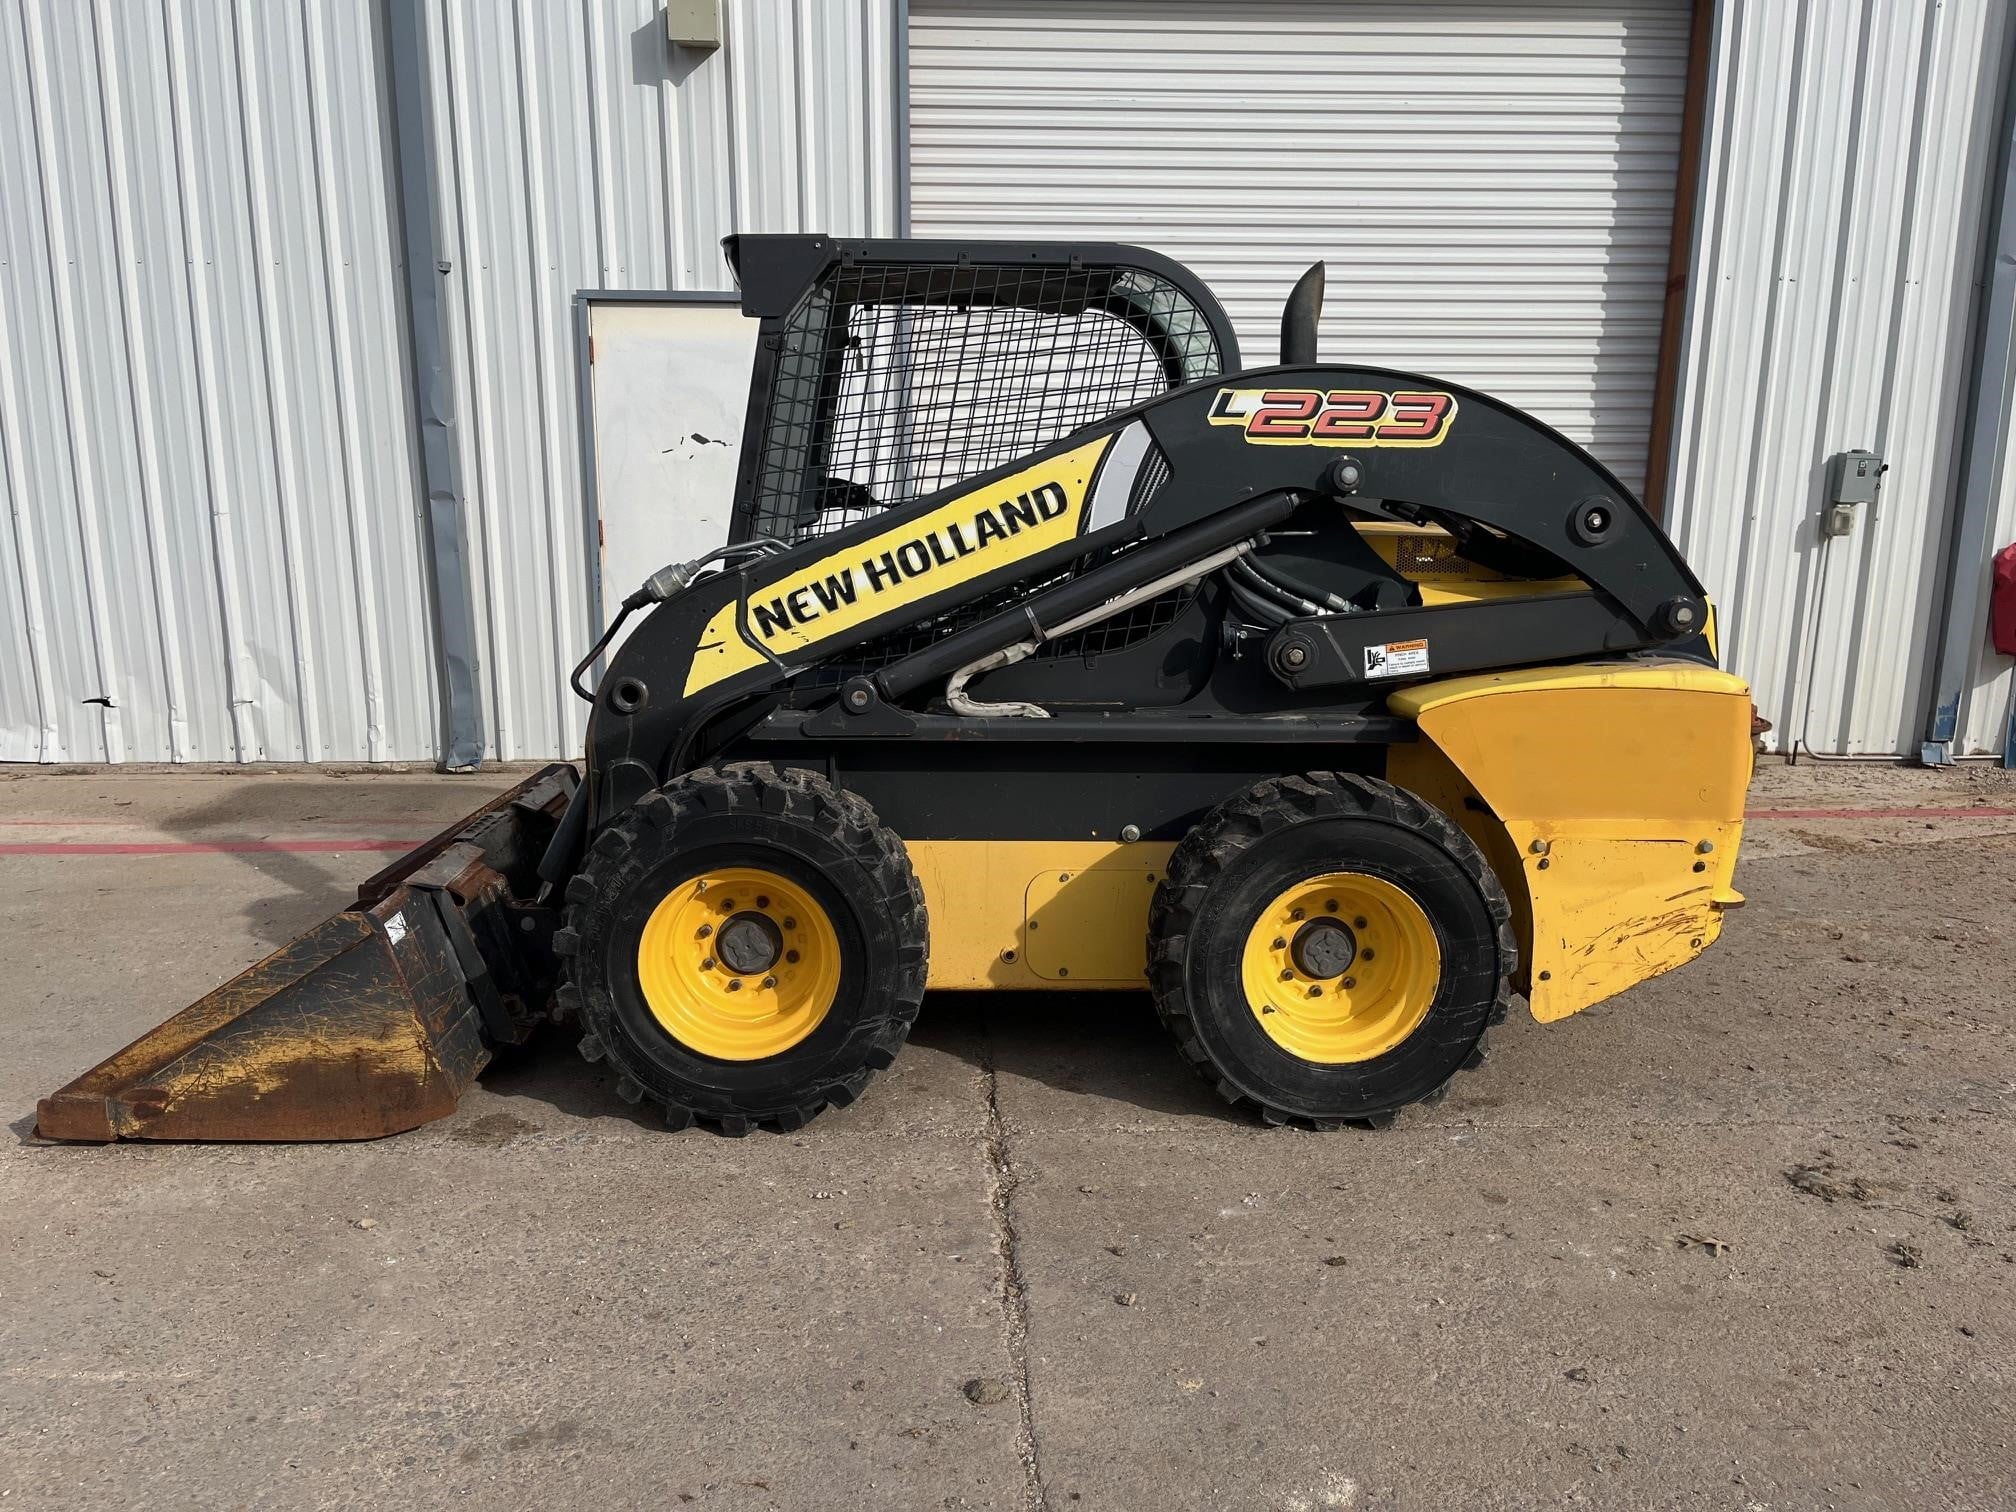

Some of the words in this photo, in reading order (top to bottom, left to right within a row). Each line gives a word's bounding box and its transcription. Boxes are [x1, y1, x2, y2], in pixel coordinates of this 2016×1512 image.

[1211, 390, 1455, 441] L223
[752, 567, 858, 639] NEW
[861, 480, 1069, 593] HOLLAND
